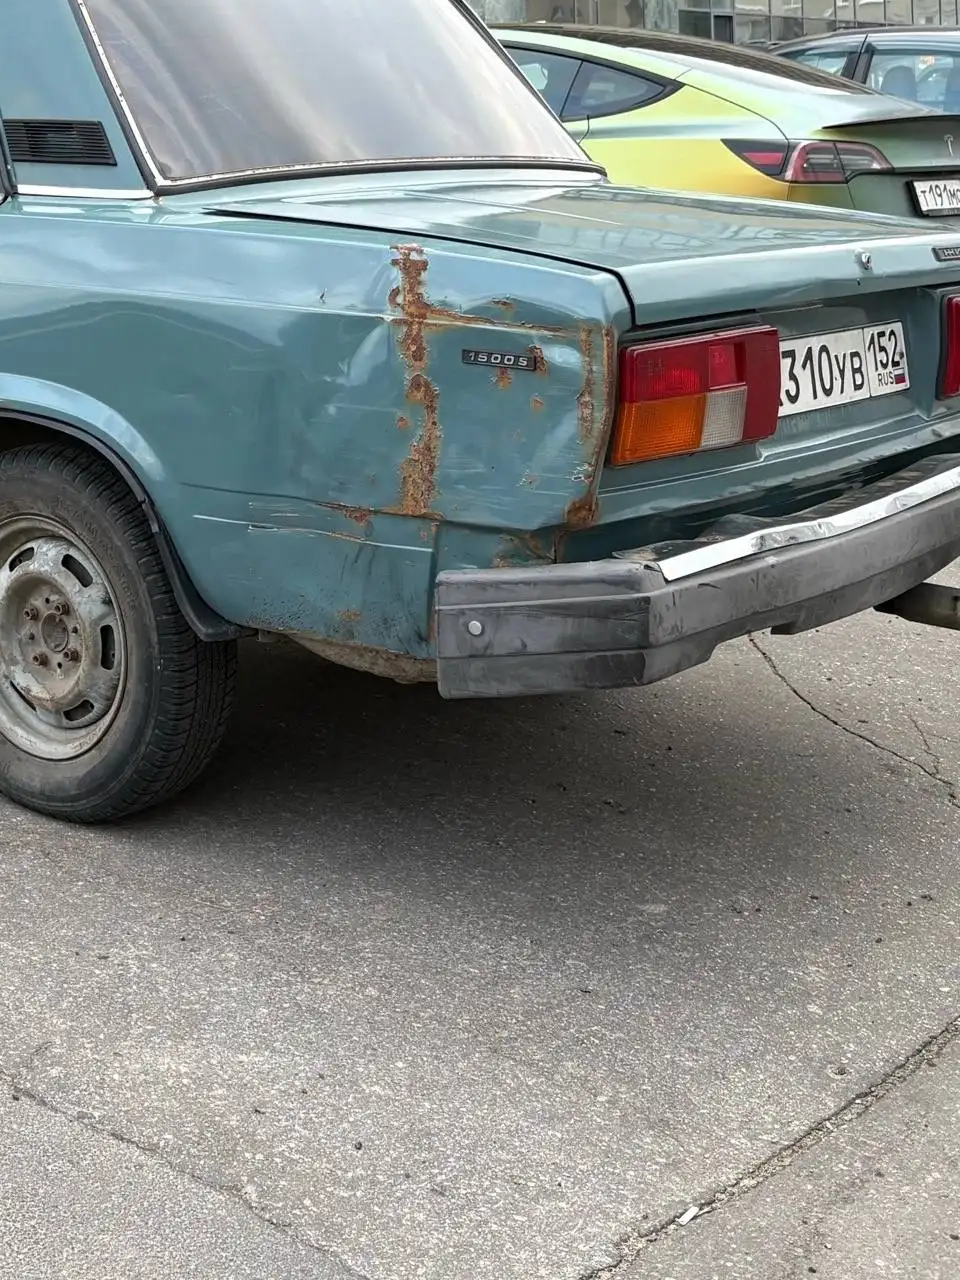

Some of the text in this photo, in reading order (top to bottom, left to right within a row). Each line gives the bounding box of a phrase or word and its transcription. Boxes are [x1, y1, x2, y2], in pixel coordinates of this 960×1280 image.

[469, 351, 528, 366] 1500S
[867, 329, 901, 372] 152
[779, 344, 865, 407] 310УВ
[877, 371, 894, 387] RUS
